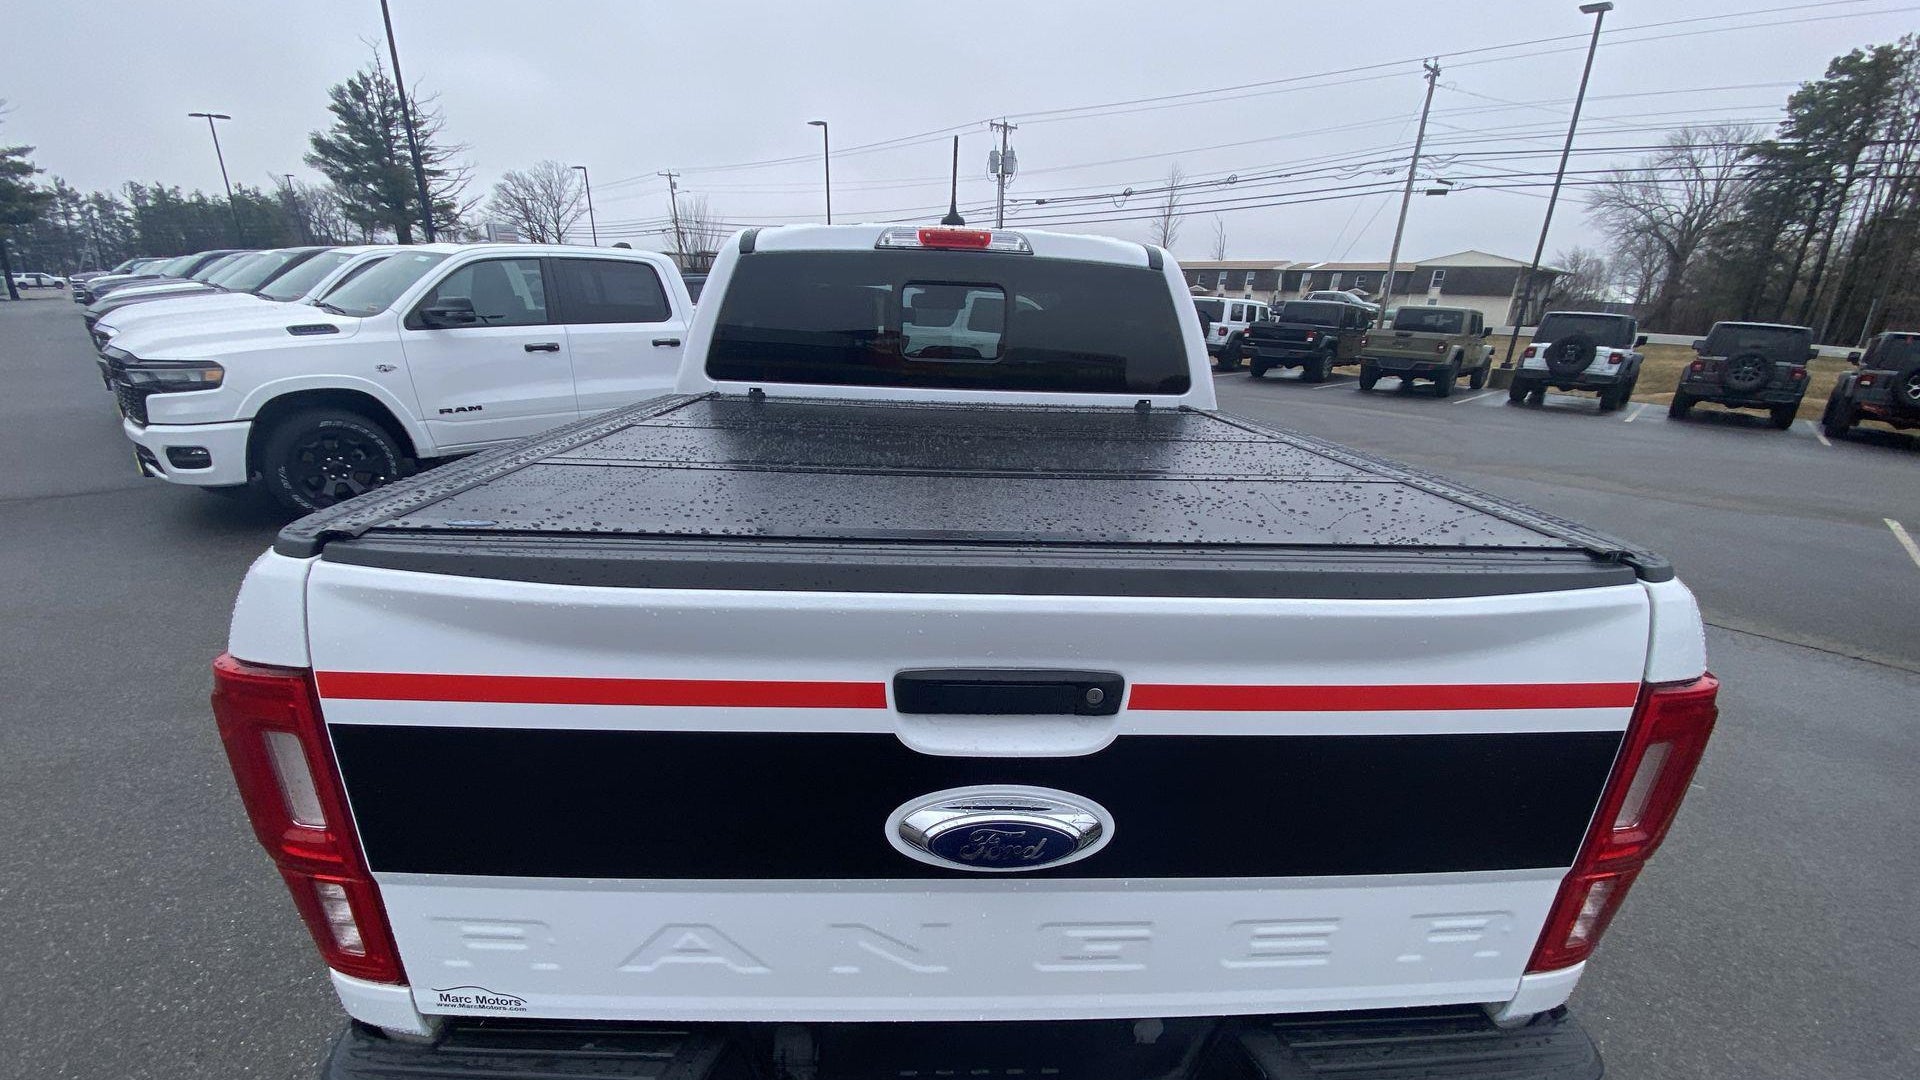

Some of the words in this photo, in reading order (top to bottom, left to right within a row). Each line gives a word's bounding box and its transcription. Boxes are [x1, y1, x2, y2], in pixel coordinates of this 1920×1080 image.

[438, 405, 483, 415] RAM
[959, 828, 1048, 860] Ford
[429, 911, 1515, 973] RANGER
[439, 993, 472, 1004] Marc
[475, 995, 522, 1006] Motors
[436, 1002, 527, 1012] www.MarcMotors.com
